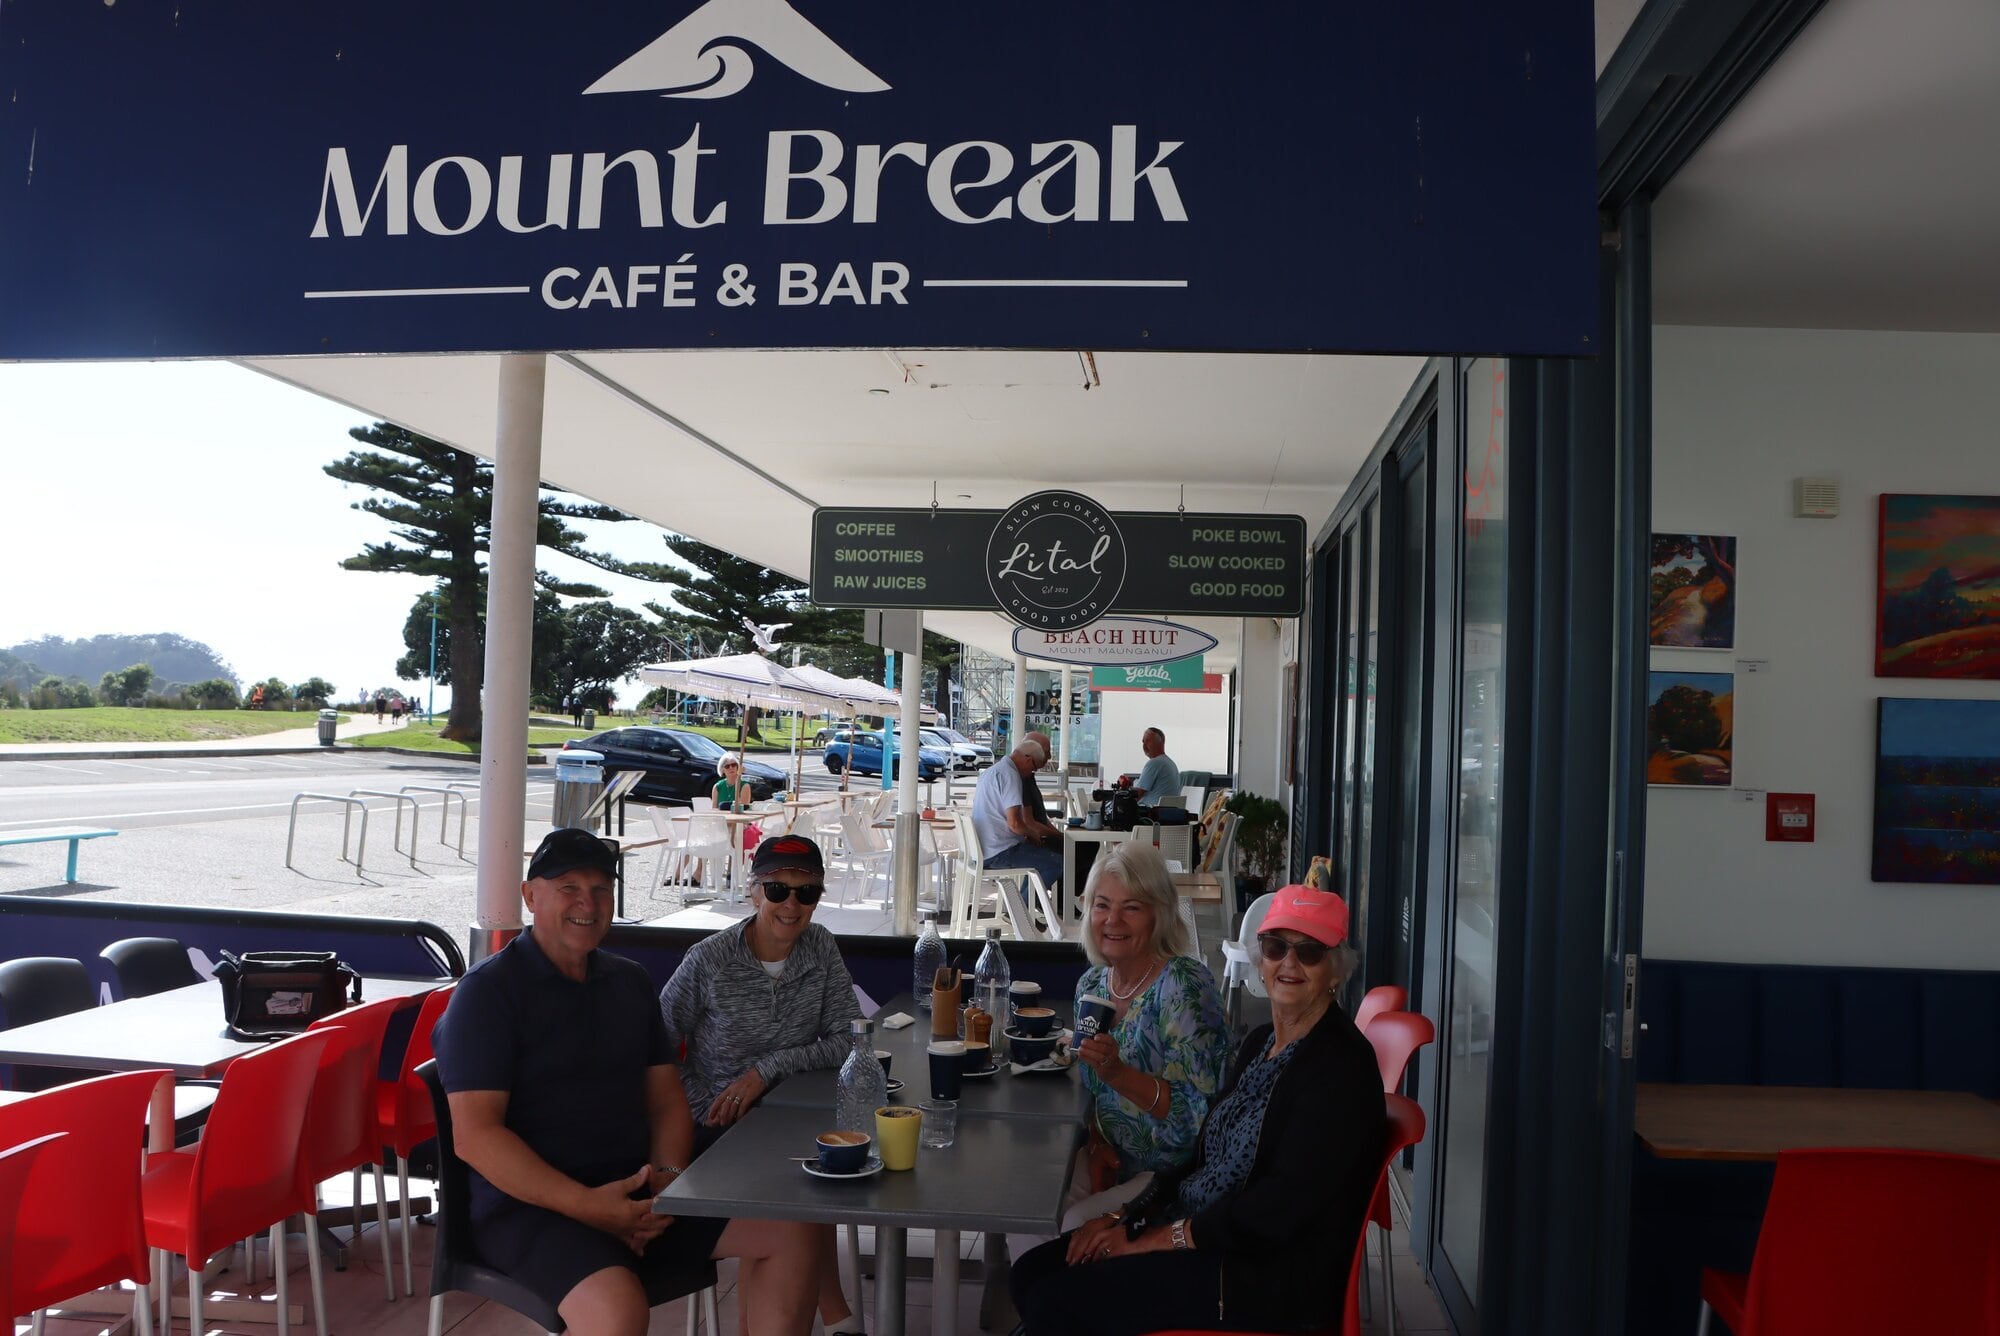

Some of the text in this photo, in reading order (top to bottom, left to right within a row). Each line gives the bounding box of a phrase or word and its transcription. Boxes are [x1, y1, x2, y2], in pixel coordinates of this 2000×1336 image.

[309, 122, 1188, 238] Mount Break
[541, 252, 910, 310] CAFÉ & BAR
[1007, 500, 1106, 533] SLOW COOKED
[836, 523, 896, 536] COFFEE
[1192, 529, 1286, 543] POKE BOWL
[834, 549, 924, 563] SMOOTHIES
[998, 534, 1111, 580] Lital
[1168, 555, 1286, 570] SLOW COOKED
[834, 576, 927, 589] RAW JUICES
[1190, 582, 1285, 597] GOOD FOOD
[1012, 599, 1097, 623] GOOD FOOD
[1043, 630, 1179, 645] BEACH HUT
[1049, 647, 1172, 656] MOUNT MAUNGANUI
